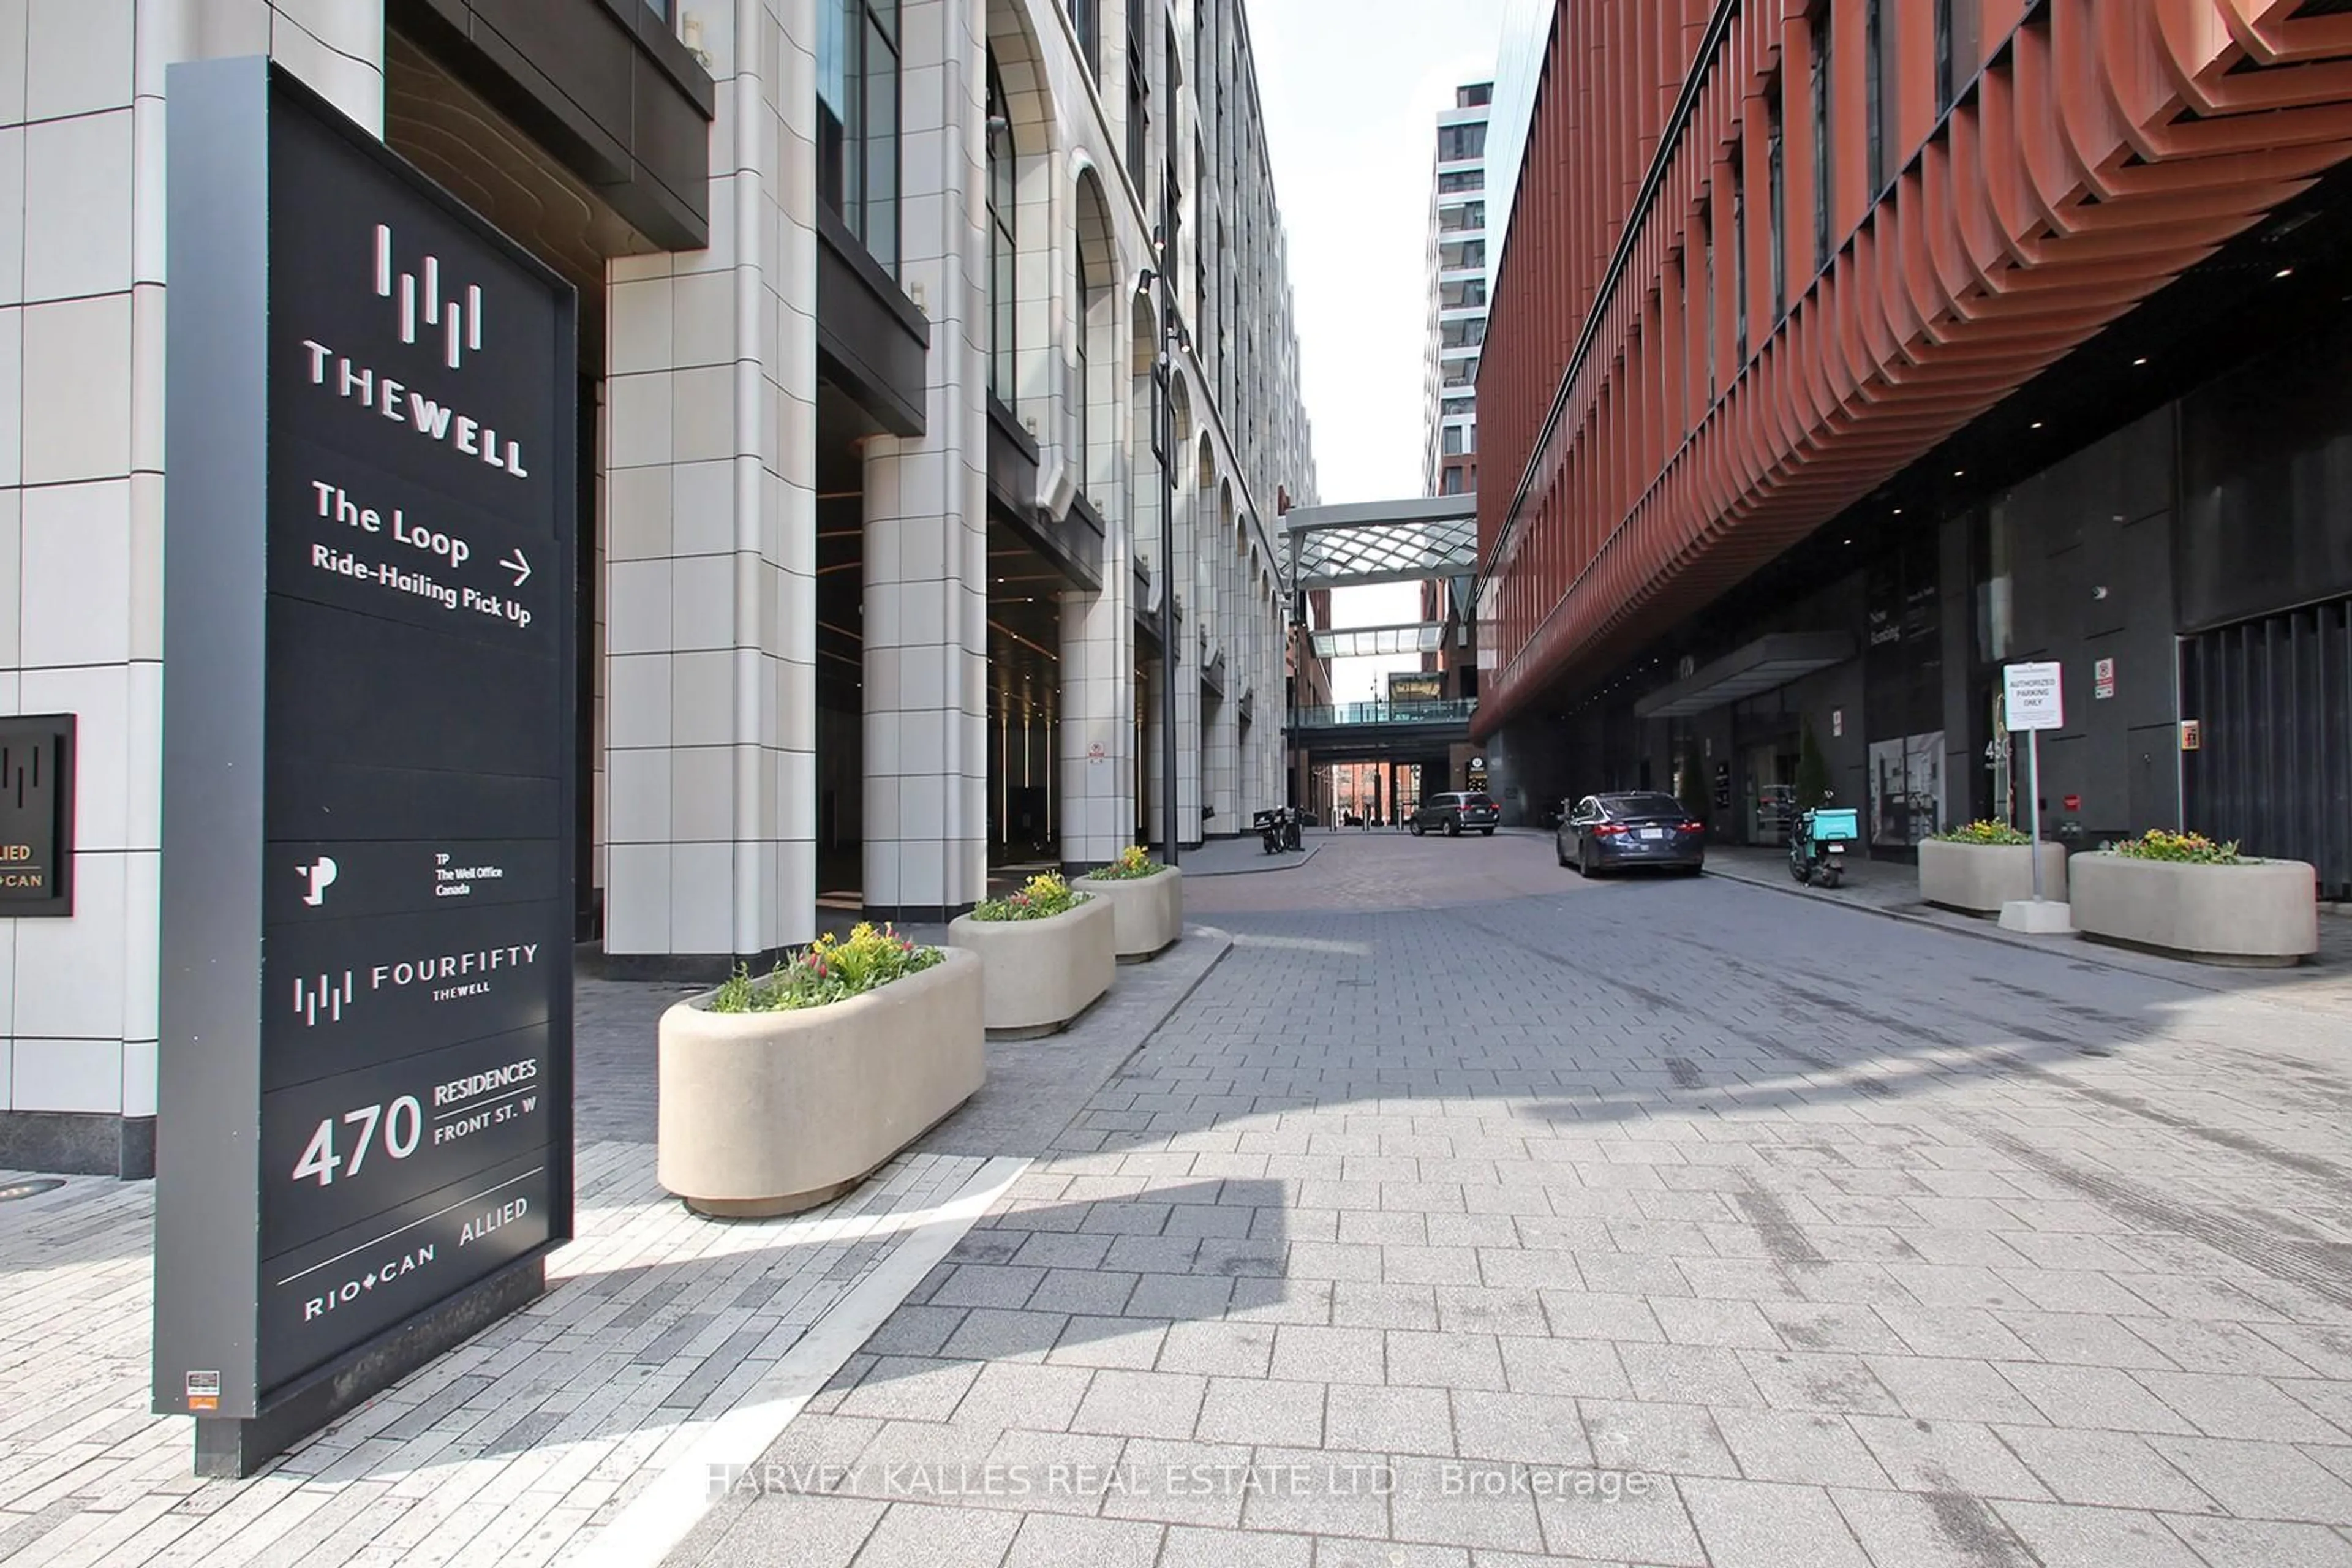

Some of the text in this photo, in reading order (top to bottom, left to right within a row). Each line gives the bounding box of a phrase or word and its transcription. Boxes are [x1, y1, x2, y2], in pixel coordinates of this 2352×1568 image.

[312, 481, 470, 568] The Loop
[312, 544, 532, 628] Ride-Hailing Pick Up
[2010, 678, 2056, 688] AUTHORIZED
[435, 853, 450, 865] TP
[435, 866, 503, 881] The Well Office
[435, 883, 470, 896] Canada
[372, 943, 538, 990] FOURFIFTY
[434, 1058, 537, 1107] RESIDENCES
[292, 1095, 423, 1186] 470
[434, 1095, 537, 1145] FRONT ST. W
[459, 1197, 528, 1247] ALLIED
